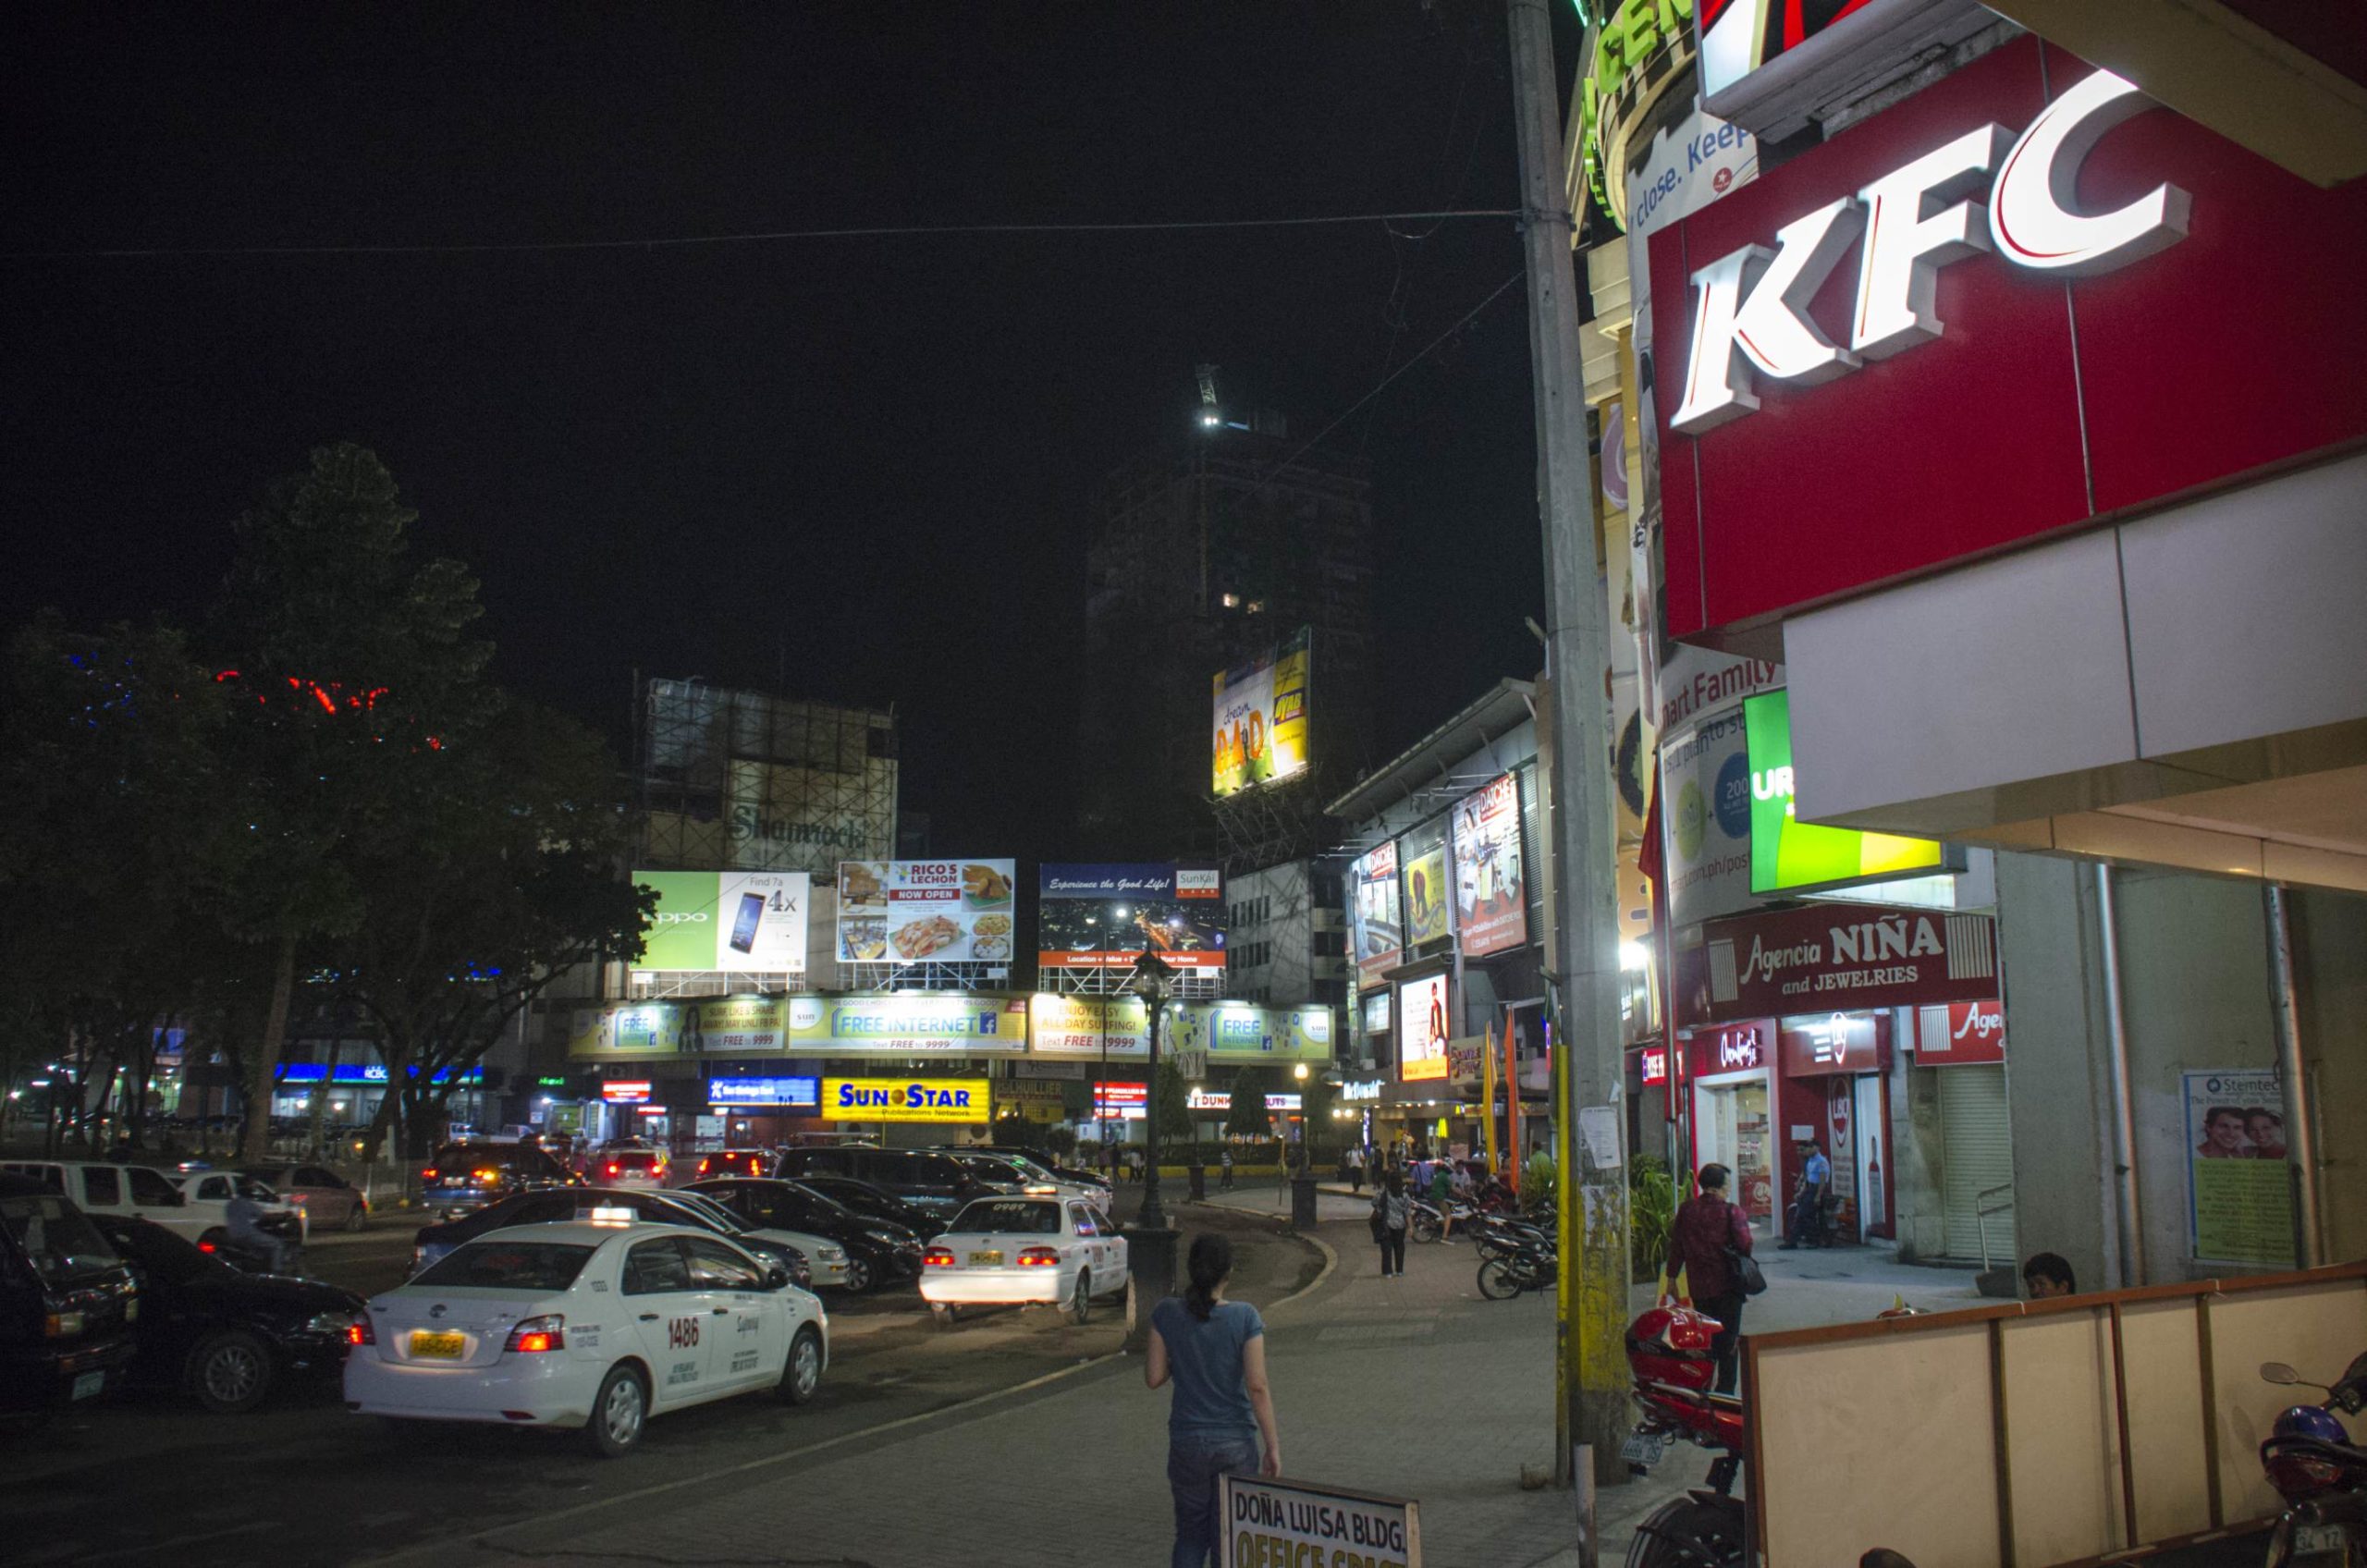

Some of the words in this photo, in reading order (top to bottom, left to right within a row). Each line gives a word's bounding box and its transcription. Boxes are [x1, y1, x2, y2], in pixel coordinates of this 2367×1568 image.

[1637, 167, 1682, 227] close.
[1670, 67, 2184, 431] KFC
[911, 864, 958, 876] RICO'S
[750, 876, 770, 887] Find
[772, 877, 783, 887] 7a
[911, 876, 958, 884] LECHON
[1049, 878, 1098, 890] Experience
[1100, 878, 1115, 888] the
[1117, 878, 1142, 891] Good
[1143, 878, 1171, 890] Life!
[899, 890, 924, 900] NOW
[925, 890, 953, 900] OPEN
[1740, 934, 1821, 986] Agencia
[1829, 913, 1944, 965] NIÑA
[1782, 975, 1810, 996] and
[1813, 965, 1919, 993] JEWELRIES
[841, 1016, 885, 1033] FREE
[889, 1016, 976, 1033] INTERNET
[1223, 1020, 1261, 1035] FREE
[723, 1035, 744, 1046] FREE
[753, 1035, 775, 1046] 9999
[889, 1040, 914, 1048] FREE
[925, 1040, 950, 1048] 9999
[1063, 1035, 1094, 1047] FREE
[1107, 1037, 1136, 1047] 9999
[1223, 1036, 1261, 1045] INTERNET
[2223, 1077, 2279, 1092] Stemtec
[839, 1084, 886, 1107] SUN
[905, 1084, 972, 1109] STAR
[881, 1109, 932, 1118] Publications
[934, 1109, 972, 1117] Network
[668, 1316, 700, 1350] 1486
[1235, 1491, 1286, 1529] DOÑA
[1289, 1501, 1349, 1541] LUISA
[1352, 1513, 1407, 1554] BLDG.
